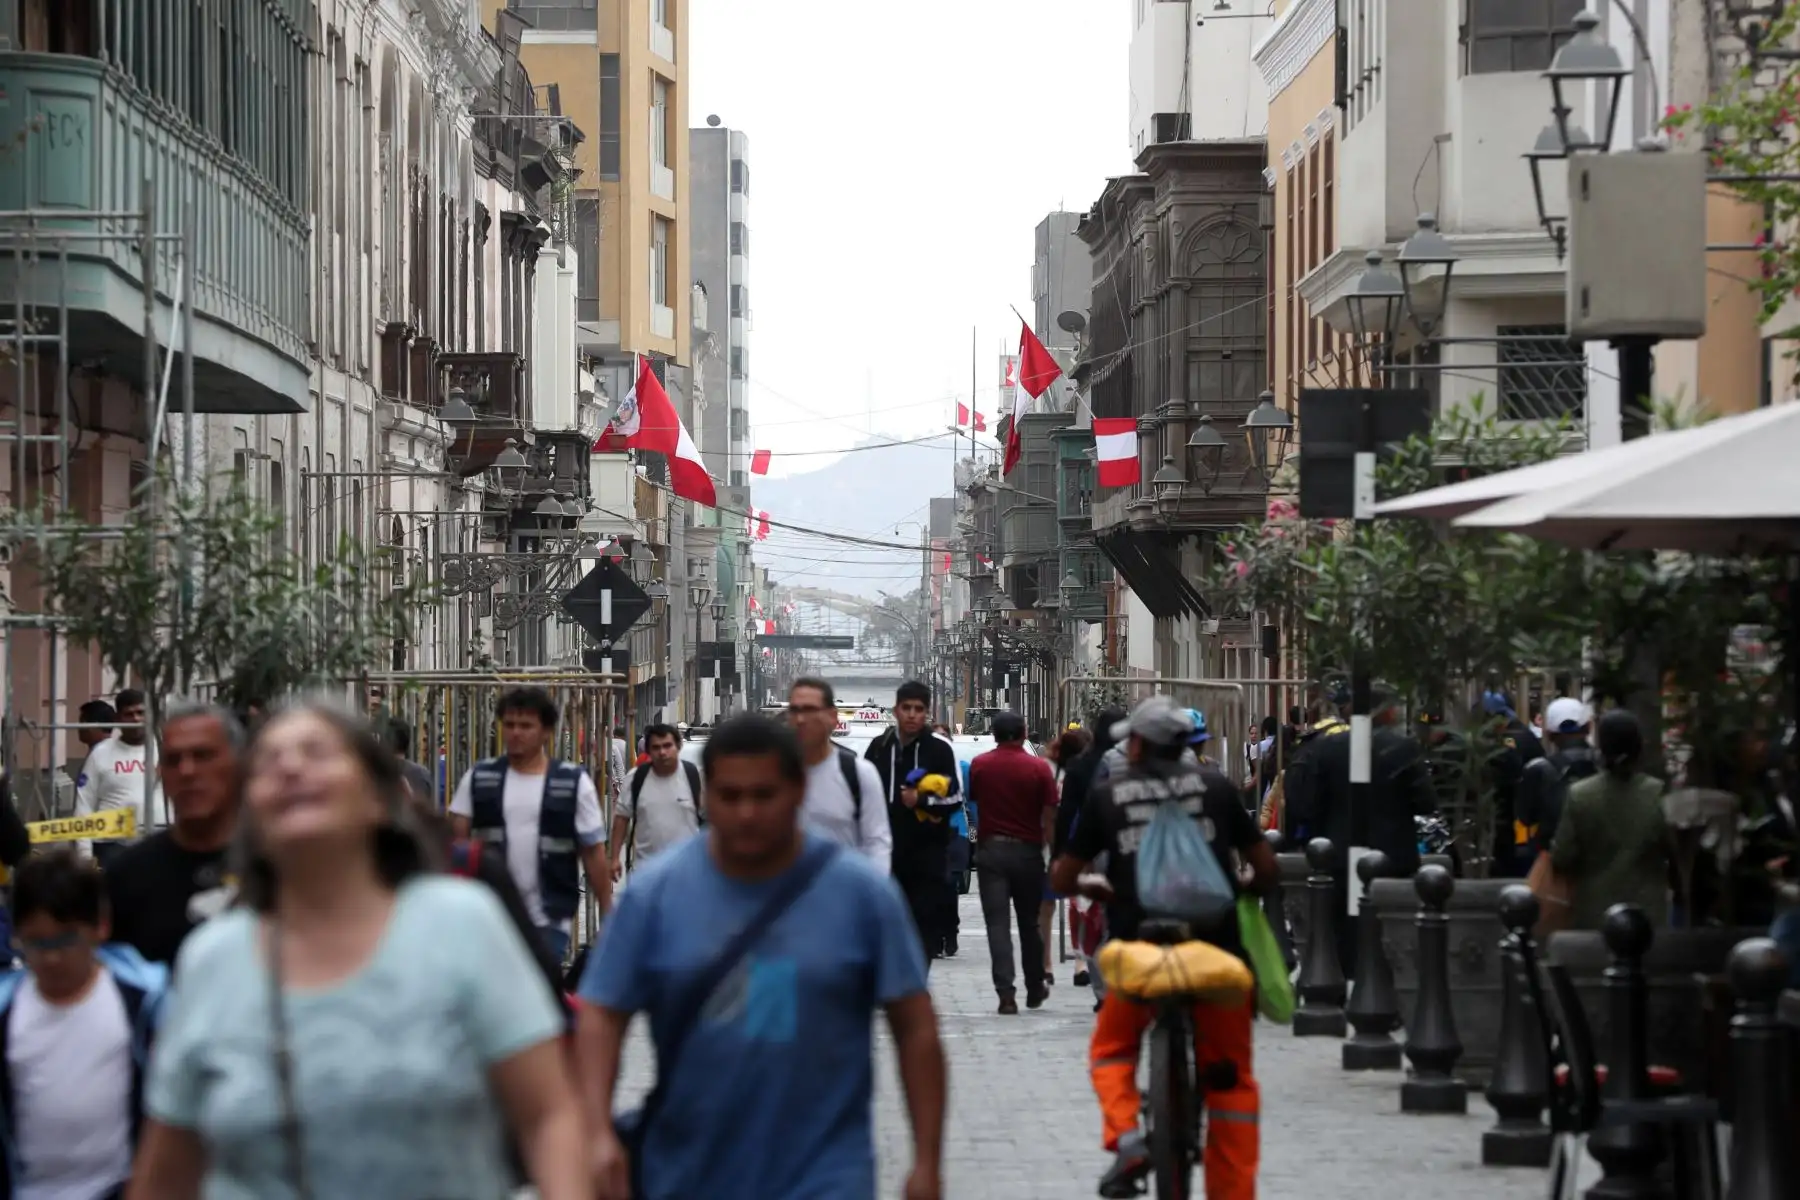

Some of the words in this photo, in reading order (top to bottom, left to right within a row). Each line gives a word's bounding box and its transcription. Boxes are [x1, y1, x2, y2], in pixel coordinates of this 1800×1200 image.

[859, 711, 880, 720] TAXI
[114, 759, 145, 774] NA
[40, 818, 106, 836] PELIGRO
